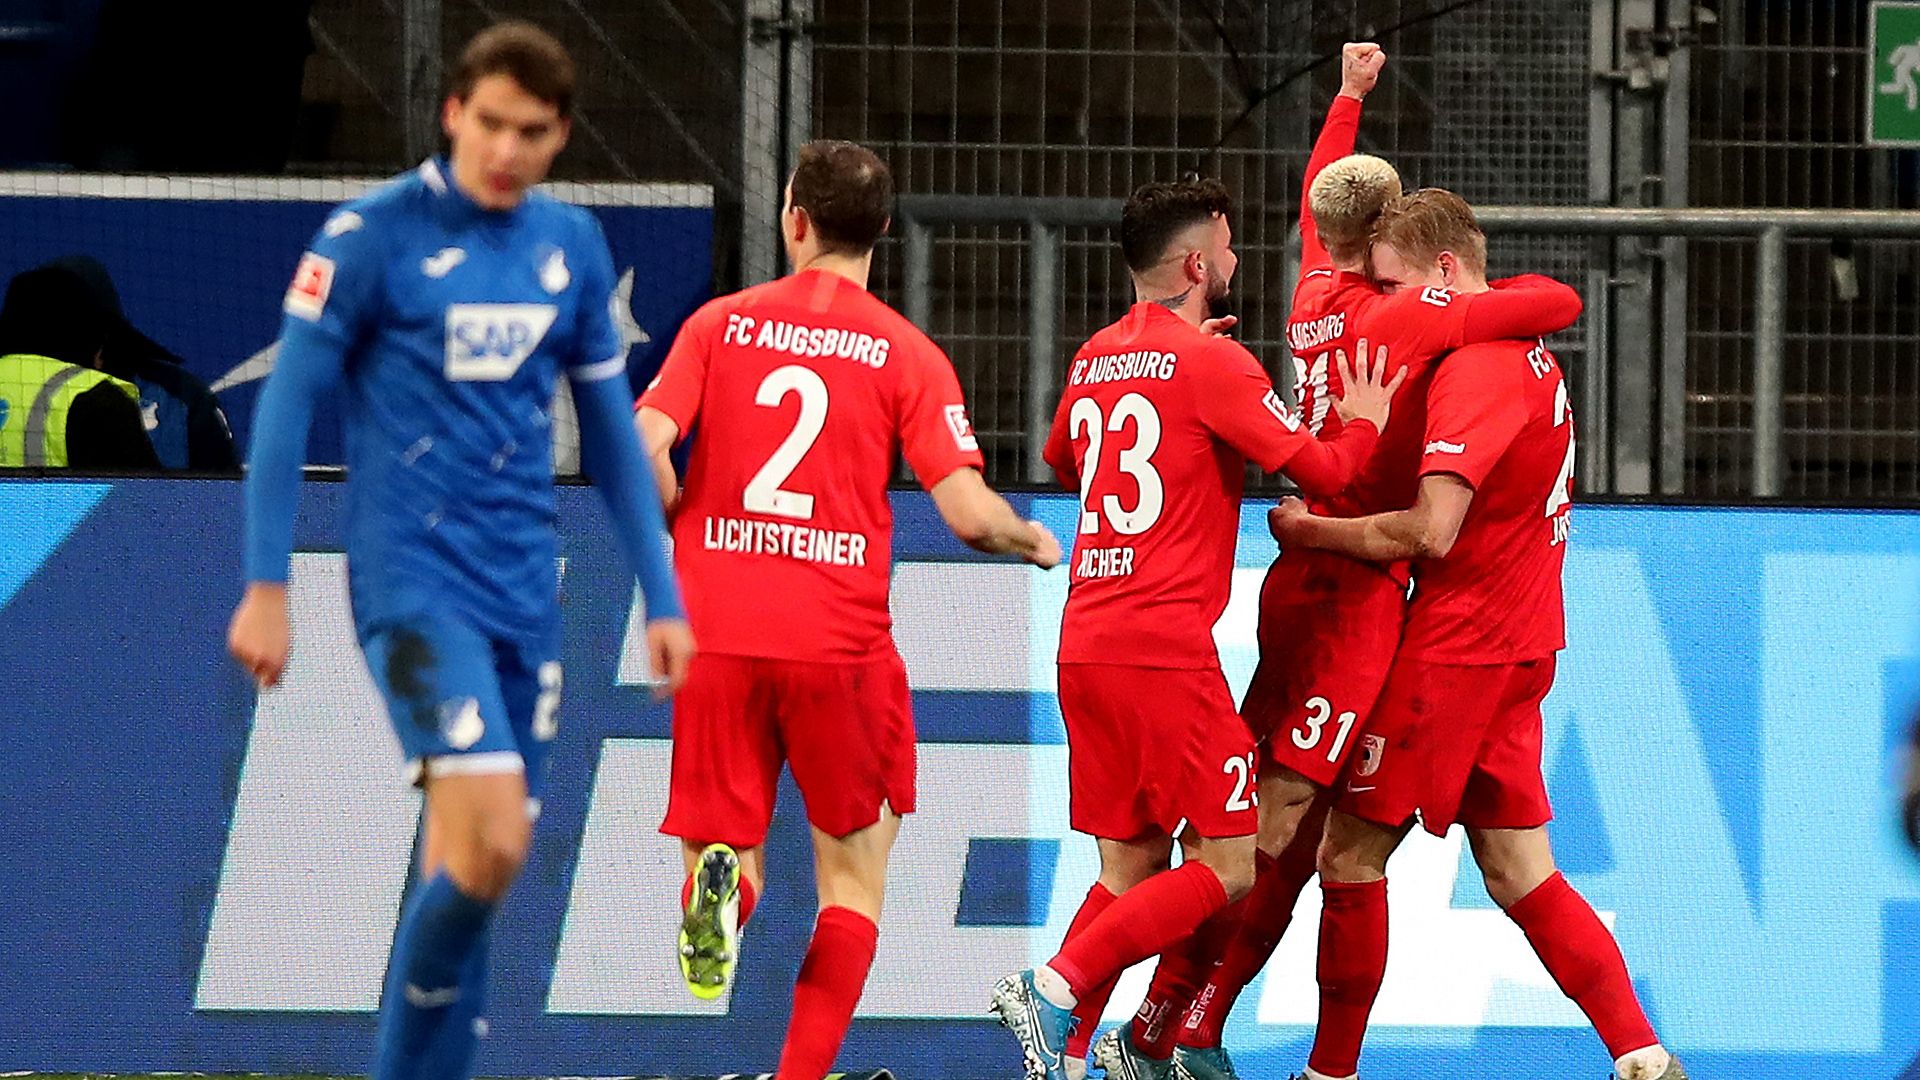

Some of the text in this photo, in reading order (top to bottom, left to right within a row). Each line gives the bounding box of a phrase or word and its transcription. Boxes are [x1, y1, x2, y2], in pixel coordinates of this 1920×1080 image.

[454, 319, 532, 359] SAP
[724, 313, 890, 368] FC AUGSBURG
[1084, 351, 1177, 385] AUGSBURG
[743, 364, 830, 520] 2
[1070, 392, 1165, 535] 23
[704, 516, 867, 567] LICHTSTEINER
[1291, 697, 1356, 763] 31
